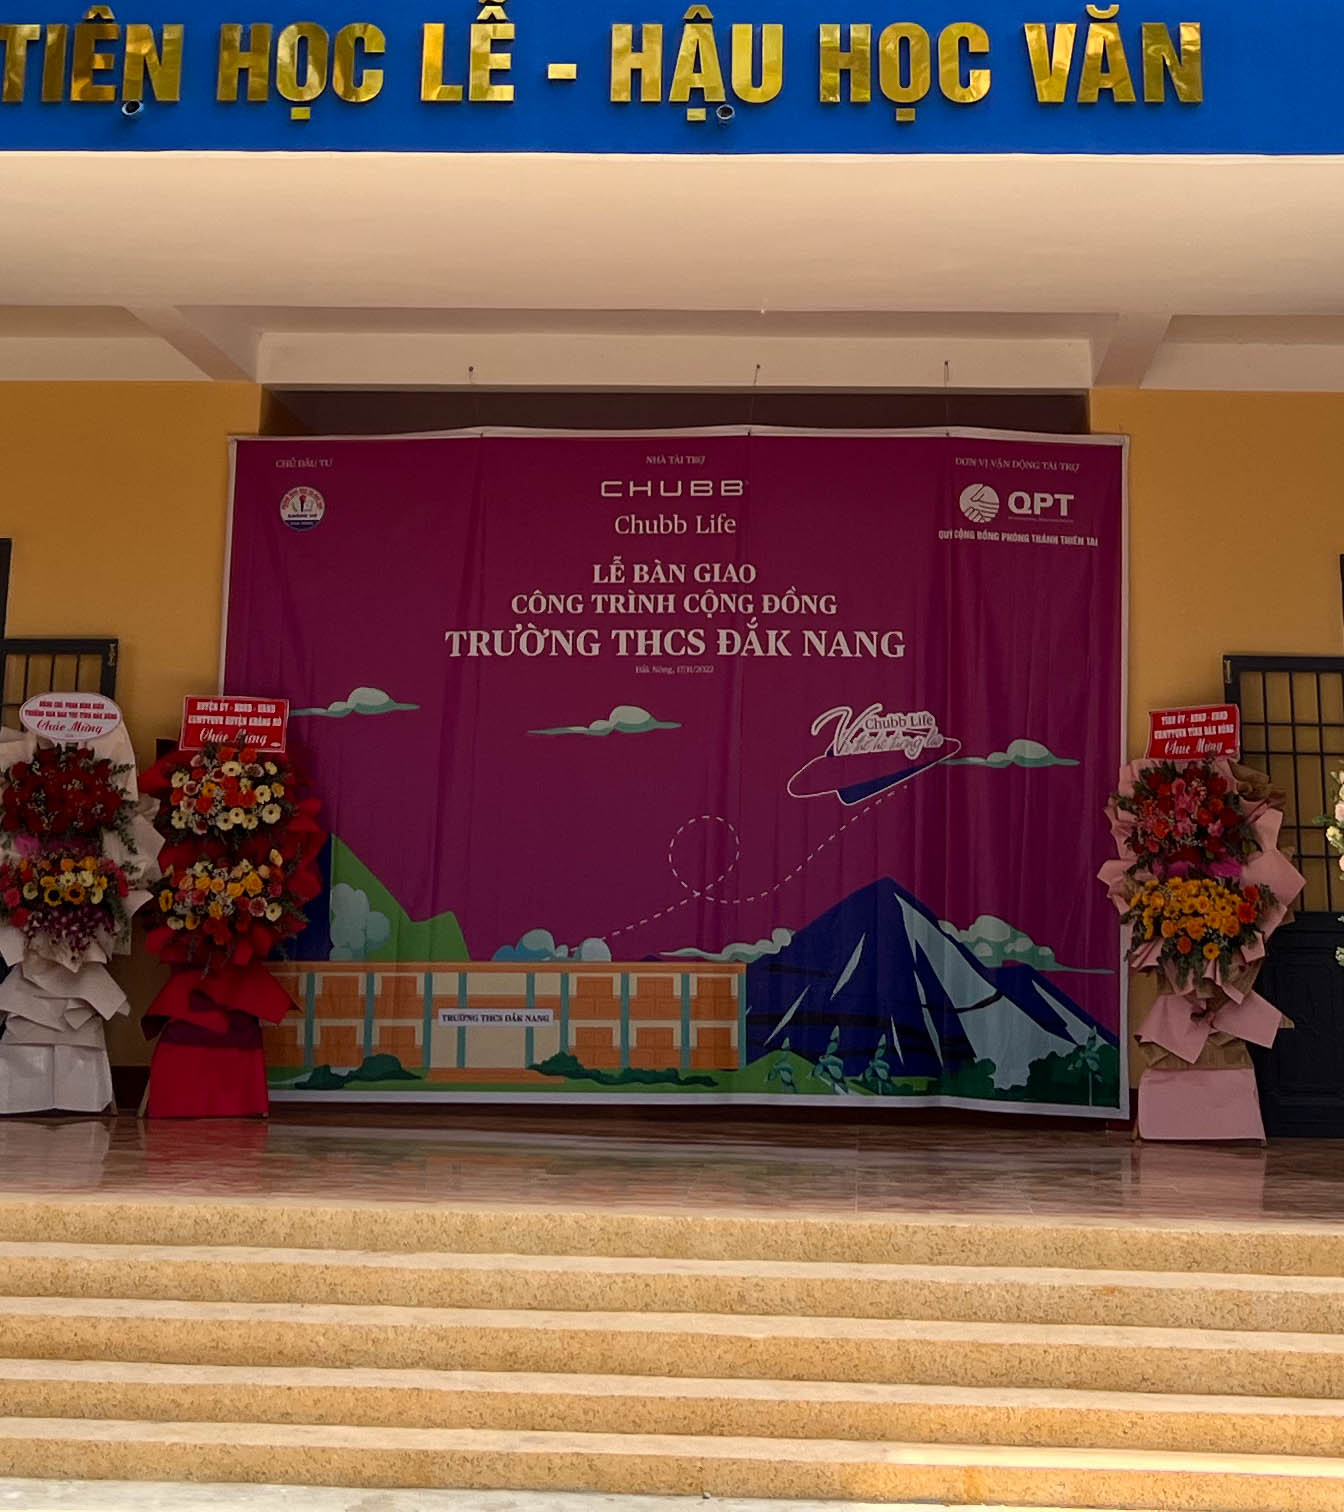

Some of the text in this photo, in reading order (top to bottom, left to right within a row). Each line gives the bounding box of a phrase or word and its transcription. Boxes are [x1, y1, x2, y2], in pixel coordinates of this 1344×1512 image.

[216, 22, 386, 120] HỌC
[547, 63, 577, 79] -
[609, 4, 784, 121] HẬU
[818, 22, 992, 122] HỌC
[1022, 3, 1204, 103] VĂN
[600, 479, 744, 497] CHUBB
[1007, 491, 1075, 517] QPT
[614, 513, 737, 535] Chubb Life
[592, 555, 757, 584] LỄ BÀN GIAO
[511, 586, 838, 618] CÔNG TRÌNH CỘNG ĐỒNG
[445, 616, 906, 658] TRƯỜNG THCS ĐẮK NANG
[865, 715, 933, 730] Chubb Life
